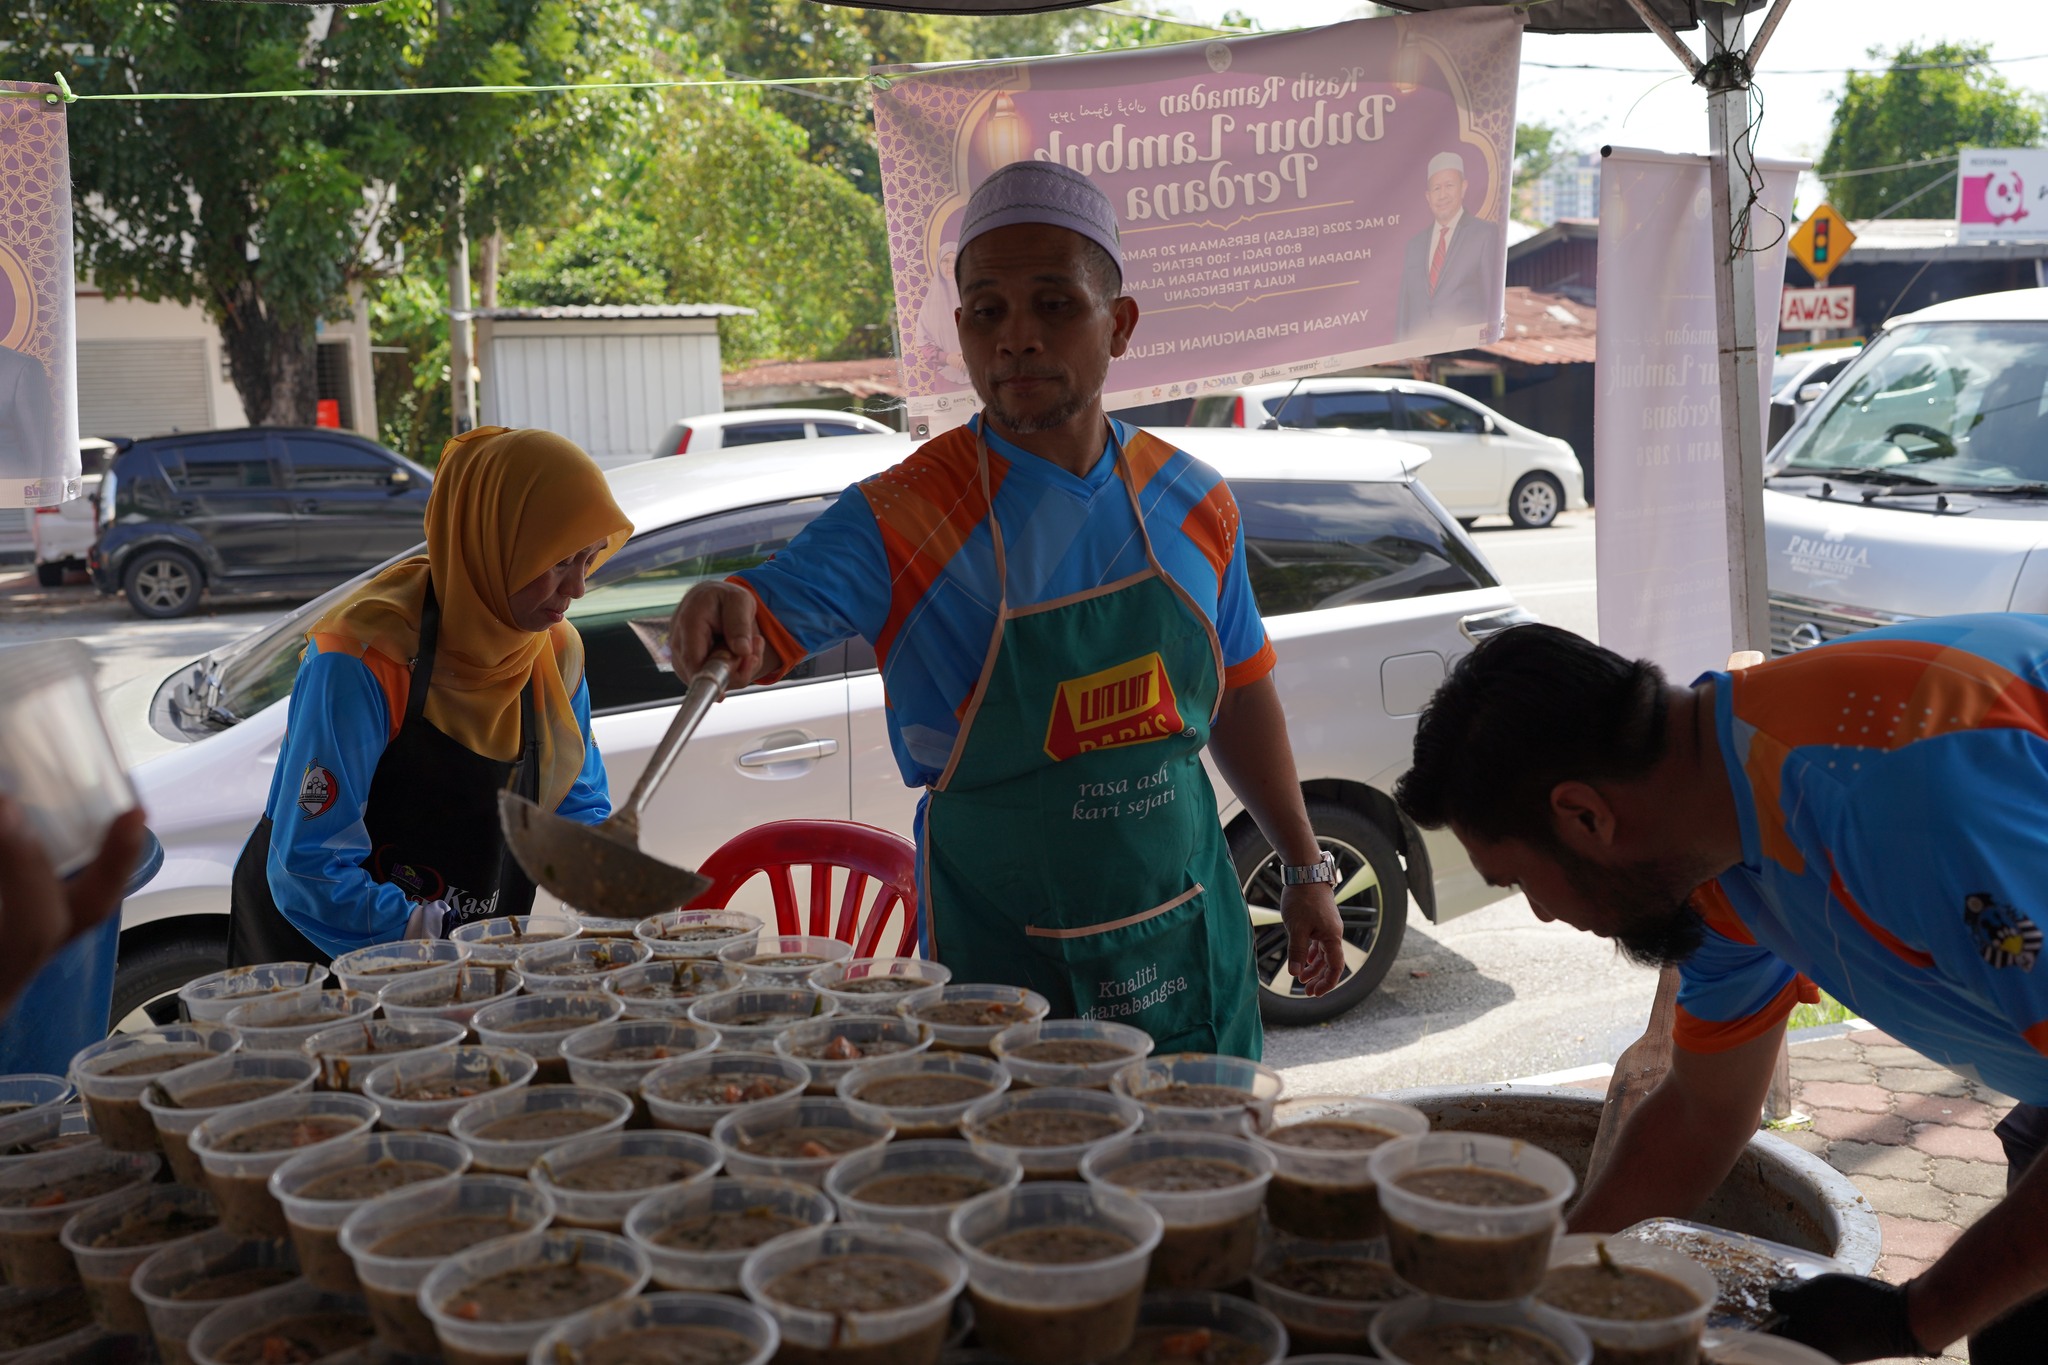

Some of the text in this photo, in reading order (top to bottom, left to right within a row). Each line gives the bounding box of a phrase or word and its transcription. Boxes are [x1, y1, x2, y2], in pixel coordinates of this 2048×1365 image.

[1786, 295, 1850, 321] AWAS
[1787, 535, 1869, 564] PRIMULA
[1078, 761, 1170, 797] rasa asli
[1072, 784, 1176, 820] kari sejati
[1098, 963, 1158, 998] Kualiti
